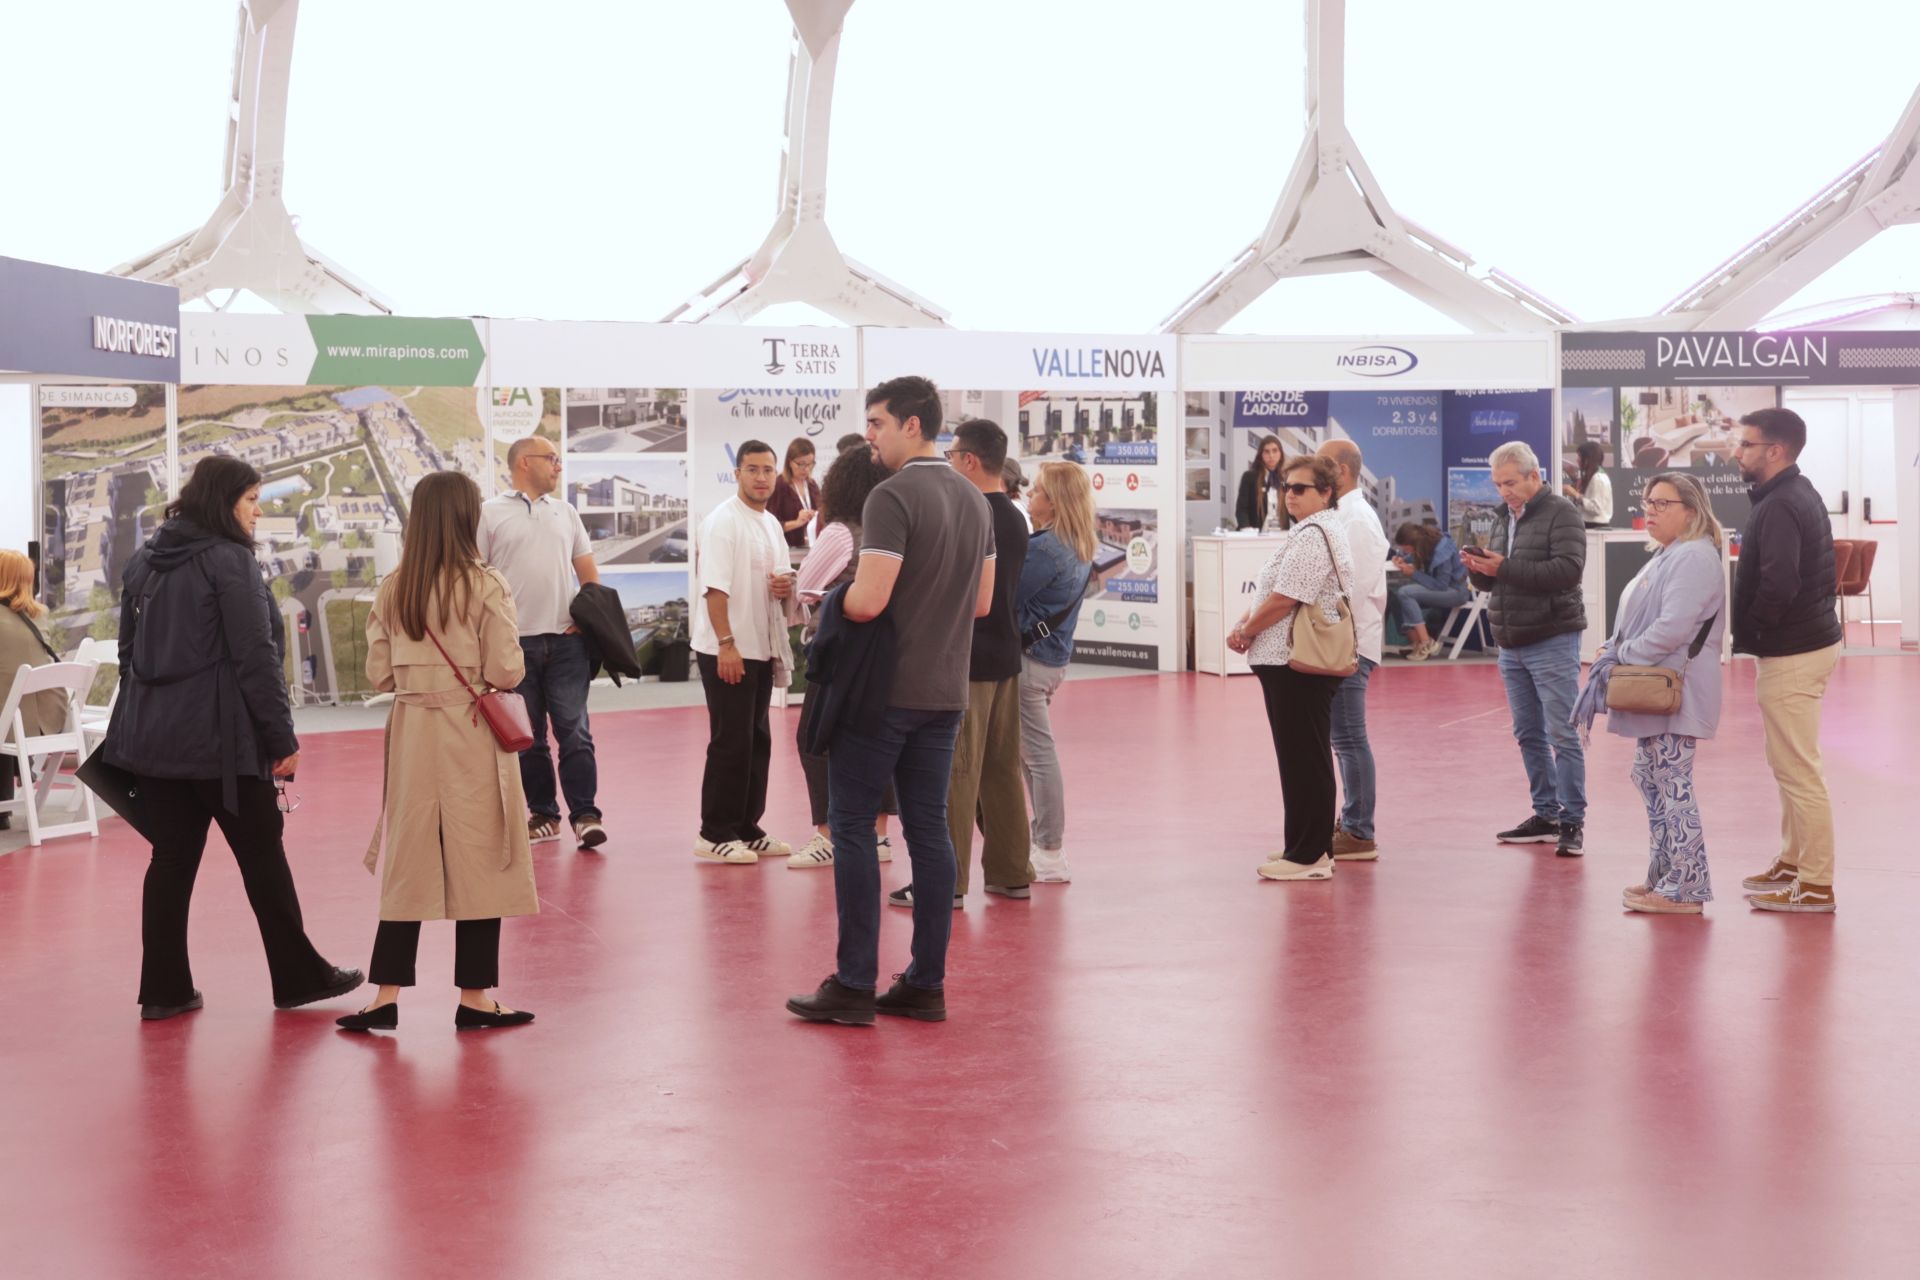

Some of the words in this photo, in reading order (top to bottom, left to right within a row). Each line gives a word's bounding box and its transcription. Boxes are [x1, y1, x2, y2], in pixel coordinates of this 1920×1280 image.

[92, 315, 177, 358] NORFOREST
[327, 344, 469, 361] www.mirapinos.com
[790, 343, 841, 358] TERRA
[1657, 336, 1828, 367] PAVALGAN
[795, 360, 837, 374] SATIS
[1032, 348, 1165, 378] VALLENOVA
[1336, 355, 1397, 366] INBISA
[60, 391, 129, 402] SIMANCAS
[1242, 389, 1282, 402] ARCO
[1284, 389, 1305, 402] DE
[1390, 396, 1438, 406] VIVIENDAS
[1242, 402, 1309, 416] LADRILLO
[731, 406, 739, 418] a
[740, 399, 755, 418] tu
[759, 405, 791, 418] nuevo
[794, 397, 841, 436] hogar
[1407, 411, 1416, 424] 3
[1418, 413, 1427, 426] y
[1429, 411, 1438, 424] 4
[1372, 425, 1438, 437] DORMITORIOS
[1117, 445, 1149, 457] 350.000
[1150, 445, 1157, 456] €
[1117, 581, 1149, 593] 255.000
[1075, 645, 1149, 660] www.vallenova.es
